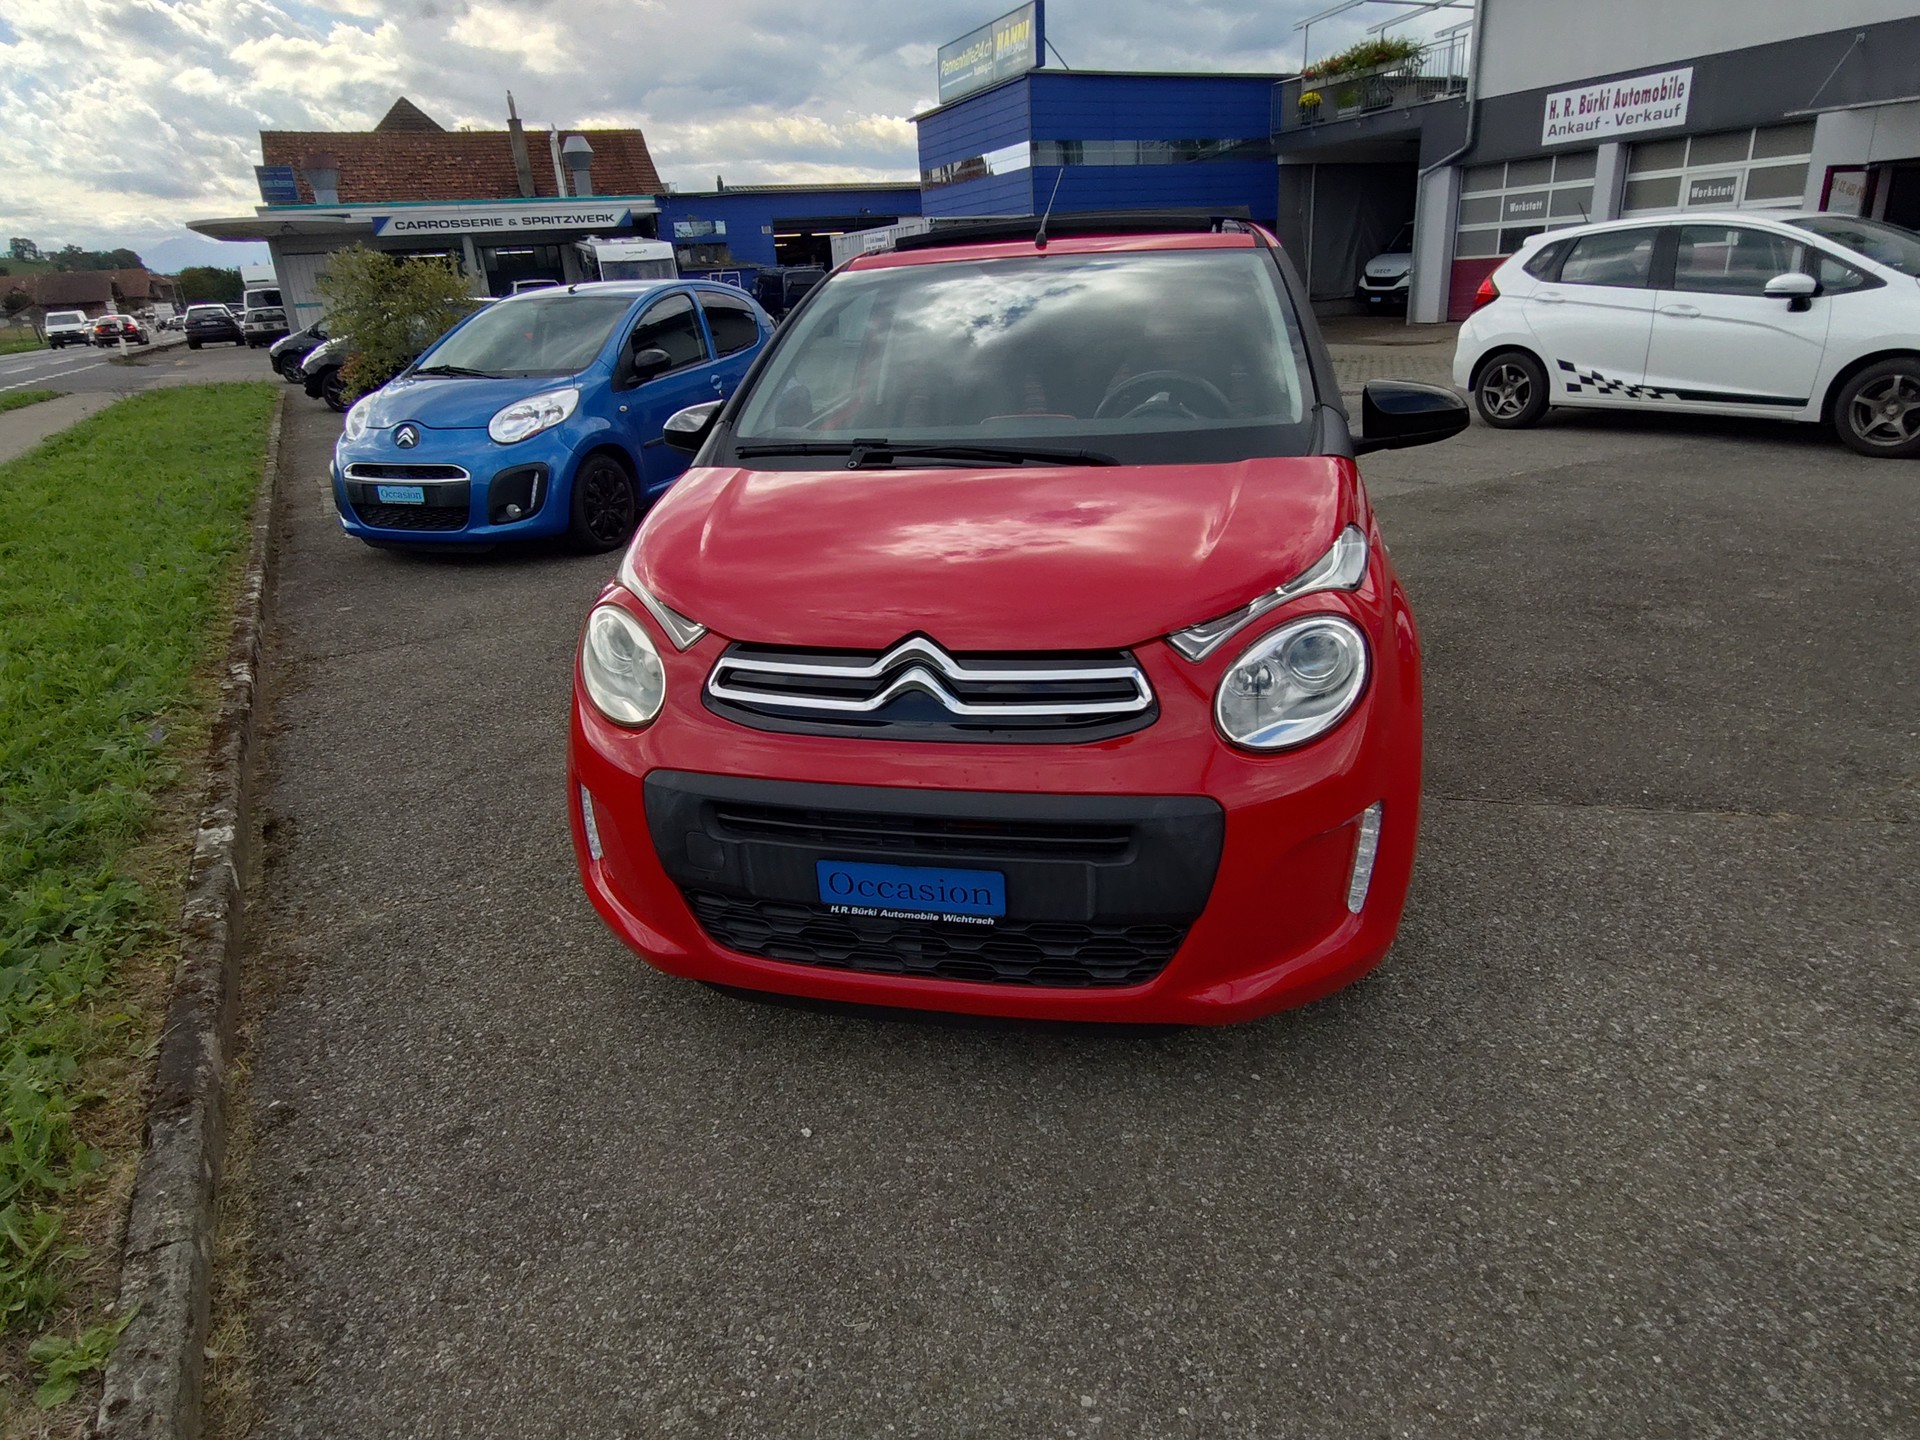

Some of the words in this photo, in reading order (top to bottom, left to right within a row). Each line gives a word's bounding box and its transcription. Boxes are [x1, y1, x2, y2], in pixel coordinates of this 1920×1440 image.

[1578, 88, 1611, 115] Bürki
[1613, 74, 1685, 109] Automobile
[1547, 116, 1600, 137] Ankauf
[1615, 103, 1682, 127] Verkauf
[1691, 185, 1735, 199] Werkstatt
[1509, 201, 1543, 213] Werkstatt
[394, 217, 504, 231] CARROSSERIE
[508, 217, 518, 226] &
[521, 213, 616, 226] SPRITZWERK
[381, 489, 422, 499] Occasion
[828, 871, 994, 906] Occasion
[880, 909, 939, 922] Automobile
[943, 914, 994, 926] Wichtrach
